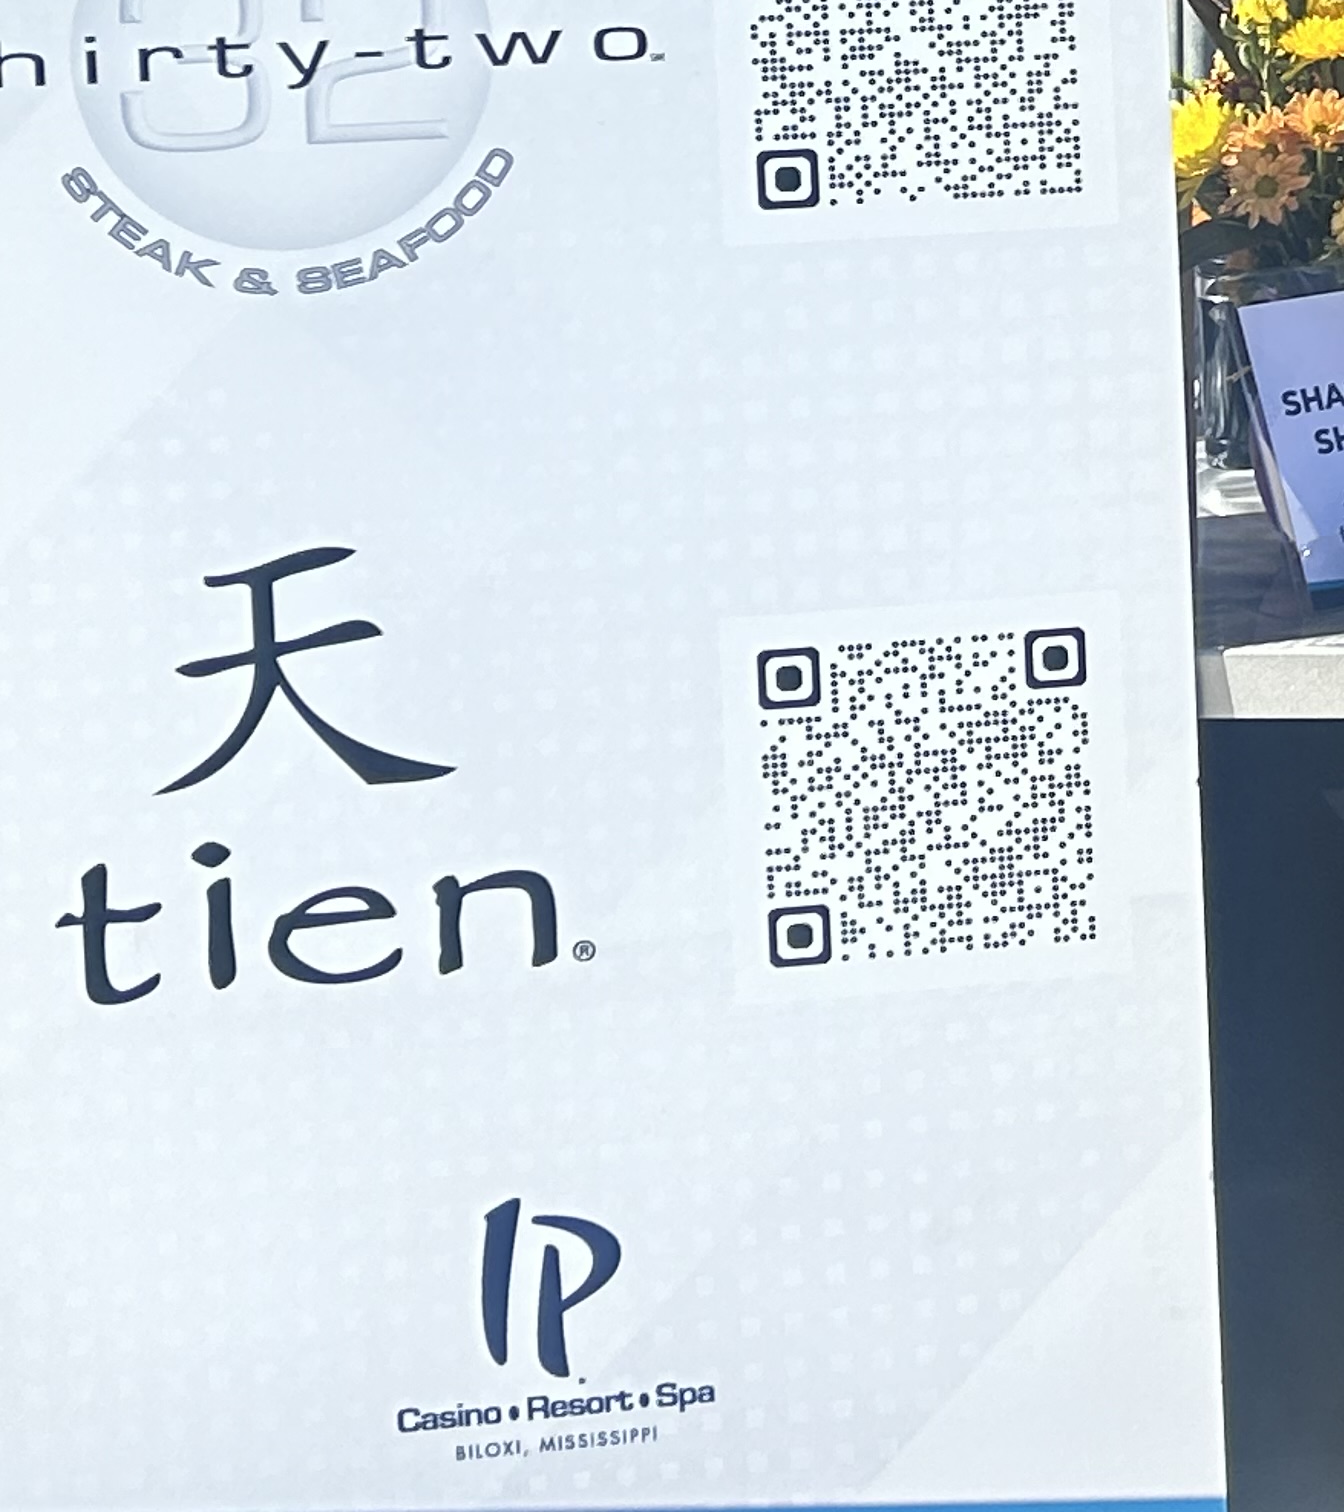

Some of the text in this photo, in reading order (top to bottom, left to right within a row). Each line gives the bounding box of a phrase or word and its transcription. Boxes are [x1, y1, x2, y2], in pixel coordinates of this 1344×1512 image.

[60, 147, 516, 297] STEAK & SEAFOOD
[151, 546, 458, 797] 天
[481, 1196, 622, 1378] IP
[396, 1381, 717, 1434] Casino Resort Spa
[454, 1424, 660, 1462] BILOXI, MISSISSIPPI
